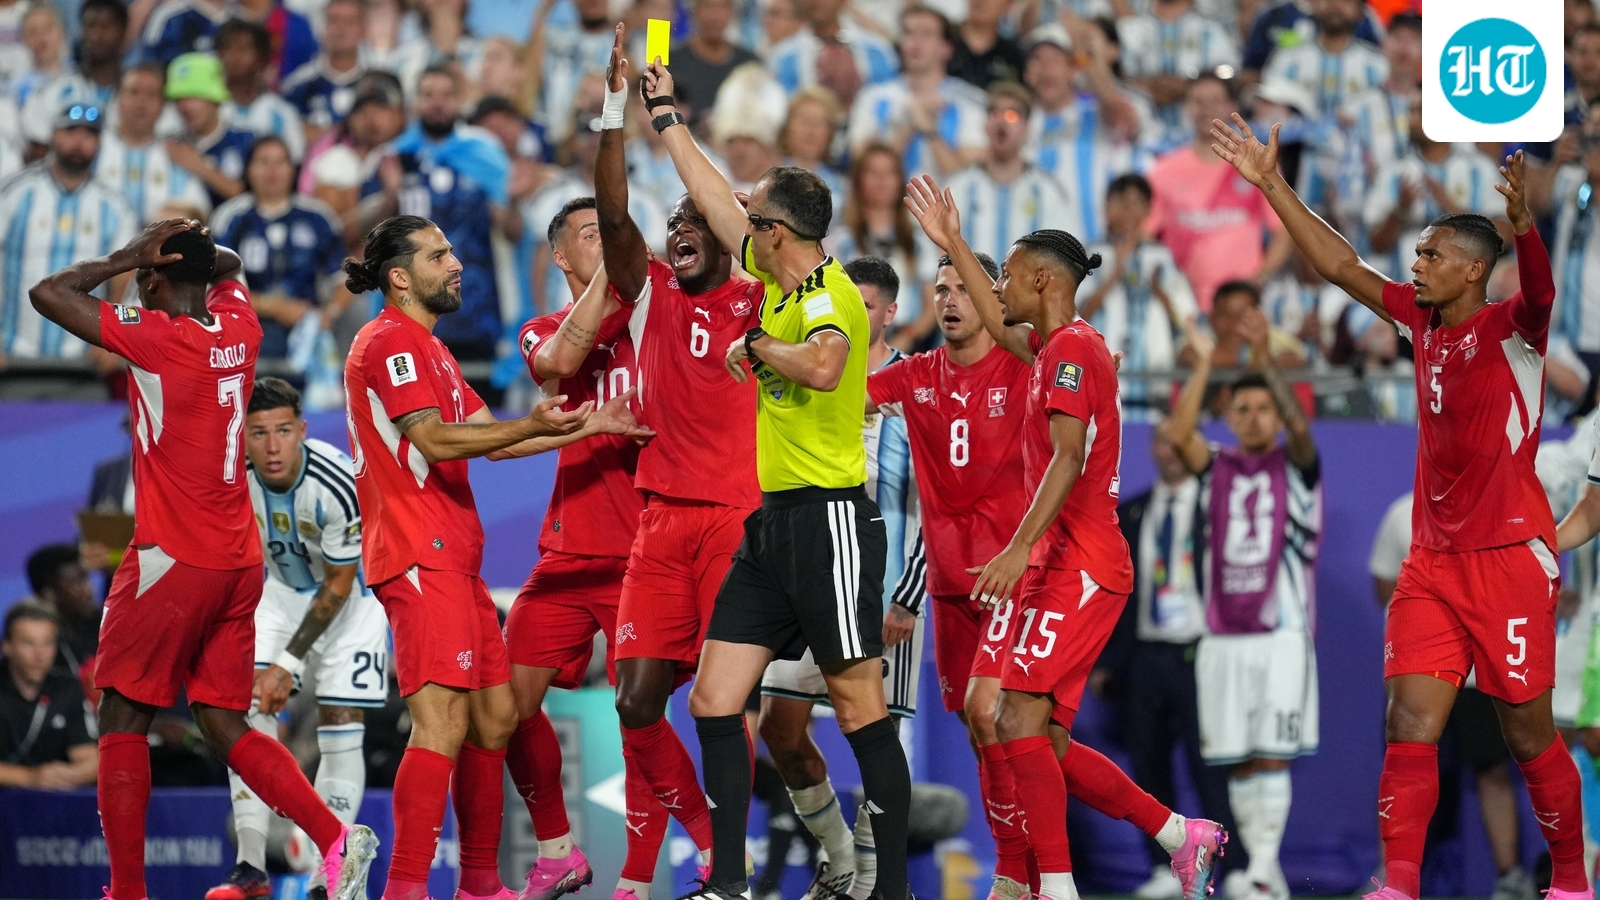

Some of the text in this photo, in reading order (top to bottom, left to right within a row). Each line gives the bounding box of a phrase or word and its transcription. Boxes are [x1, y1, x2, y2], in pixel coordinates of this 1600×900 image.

[690, 321, 710, 358] 6
[592, 366, 630, 411] 10
[1430, 366, 1443, 414] 5
[217, 373, 246, 484] 7
[950, 418, 969, 467] 8
[267, 541, 312, 567] 24
[987, 599, 1014, 642] 8
[1012, 607, 1066, 659] 15
[1506, 617, 1529, 666] 5
[352, 651, 385, 691] 24
